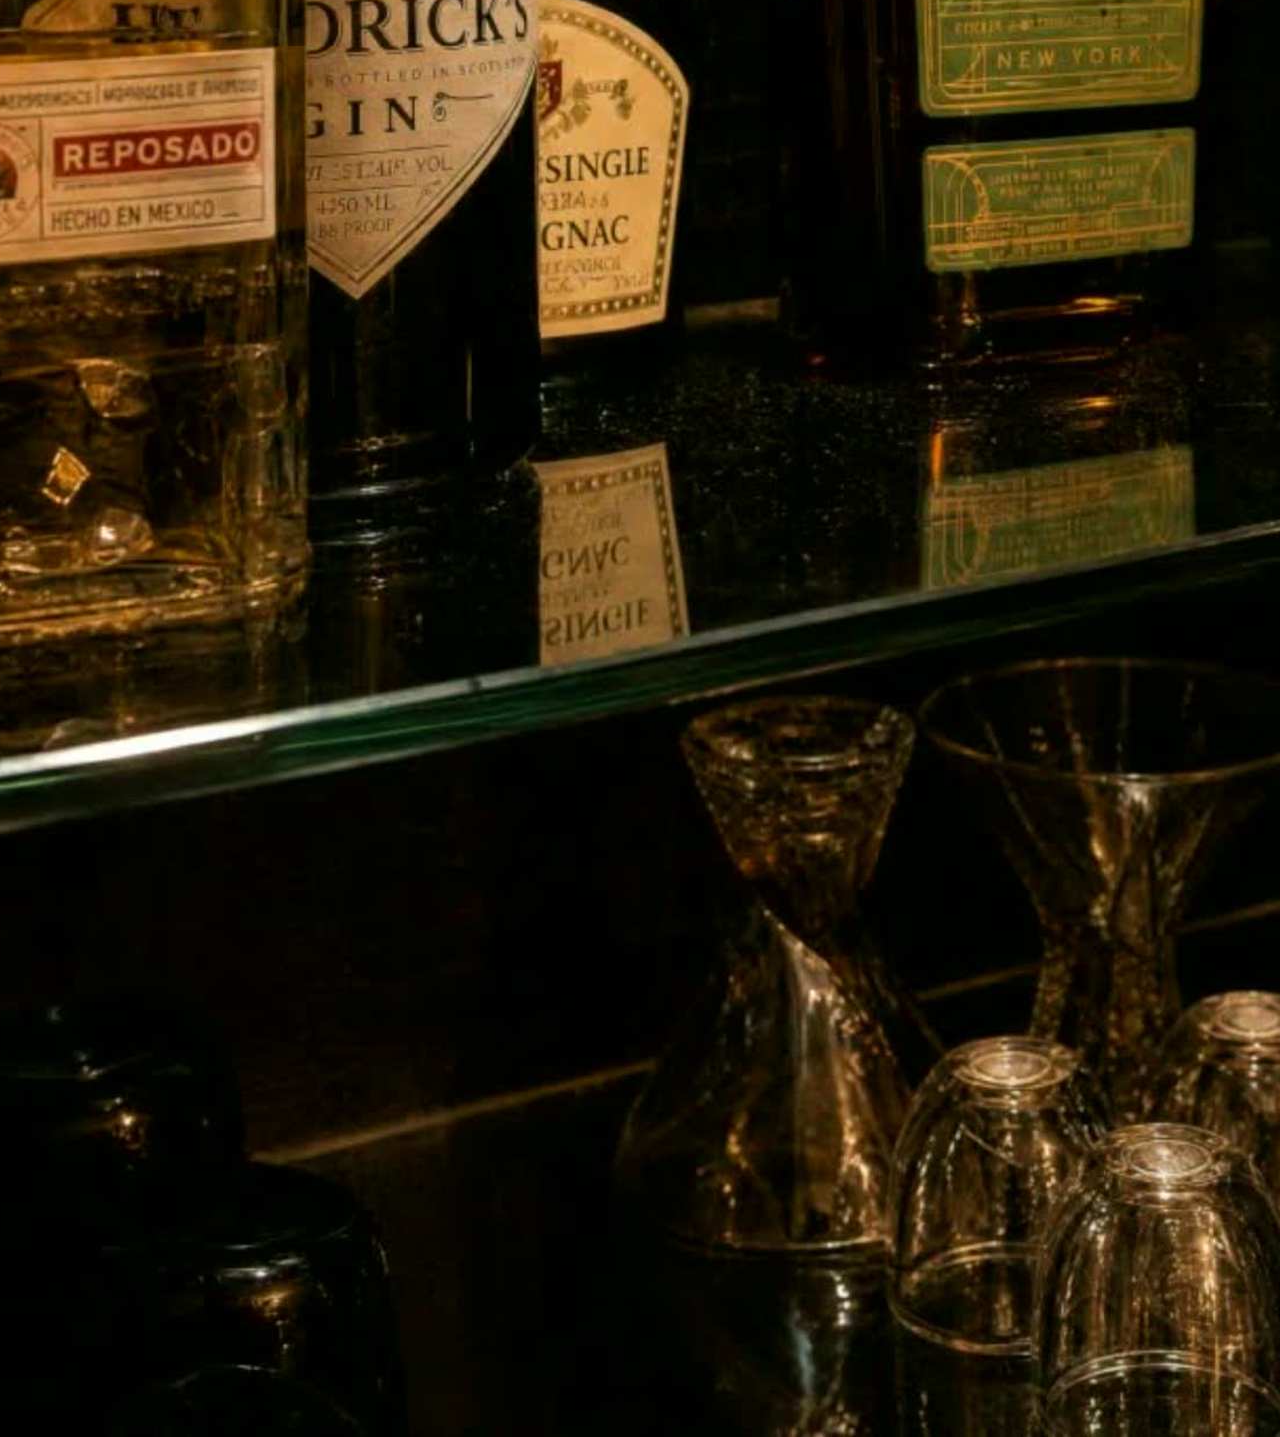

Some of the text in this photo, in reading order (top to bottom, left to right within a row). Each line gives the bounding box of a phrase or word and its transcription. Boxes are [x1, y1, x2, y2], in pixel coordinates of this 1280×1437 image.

[997, 46, 1144, 69] NEW YORK
[325, 69, 421, 87] BOTTLED
[61, 130, 256, 173] REPOSADO
[542, 146, 649, 184] SINGLE
[51, 199, 216, 231] HECHO EN MEXICO
[344, 218, 396, 237] PROOF
